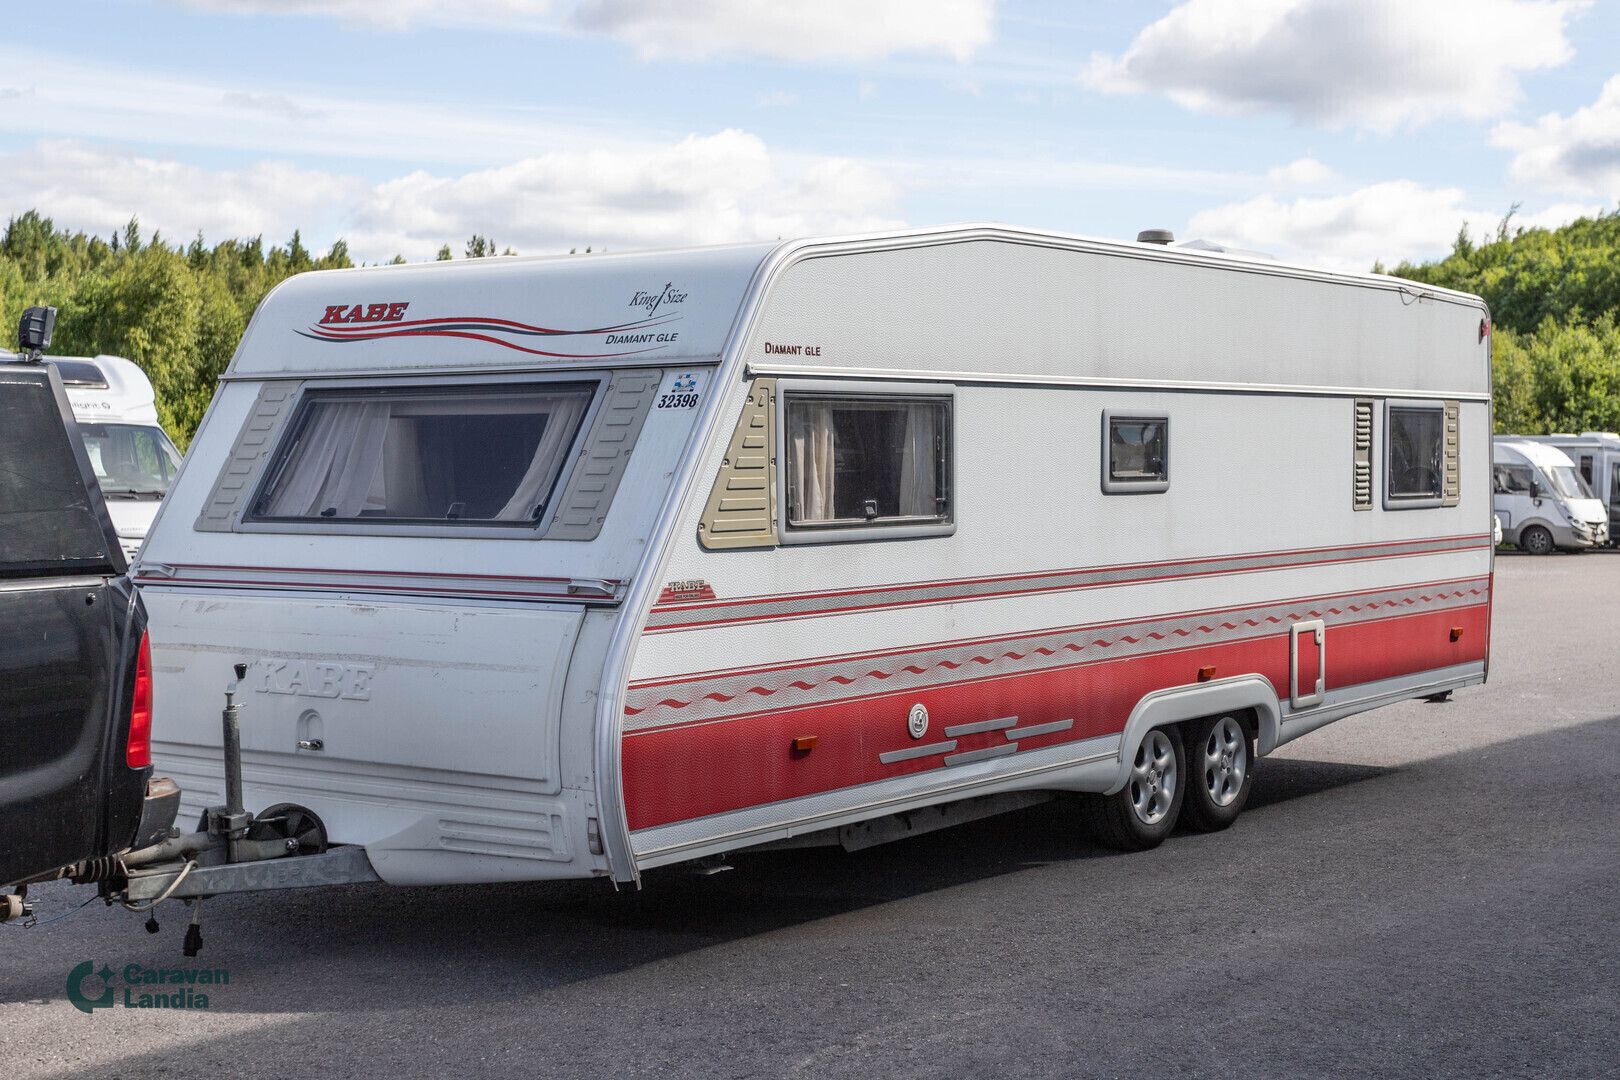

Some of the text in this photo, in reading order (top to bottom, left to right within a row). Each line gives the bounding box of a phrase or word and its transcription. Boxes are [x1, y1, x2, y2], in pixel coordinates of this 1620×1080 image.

[628, 288, 688, 310] King Size
[319, 302, 409, 324] KABE
[605, 333, 679, 345] DIAMANT GLE
[764, 342, 821, 357] DIAMANT GLE
[657, 393, 699, 409] 32398
[668, 580, 704, 592] KABE
